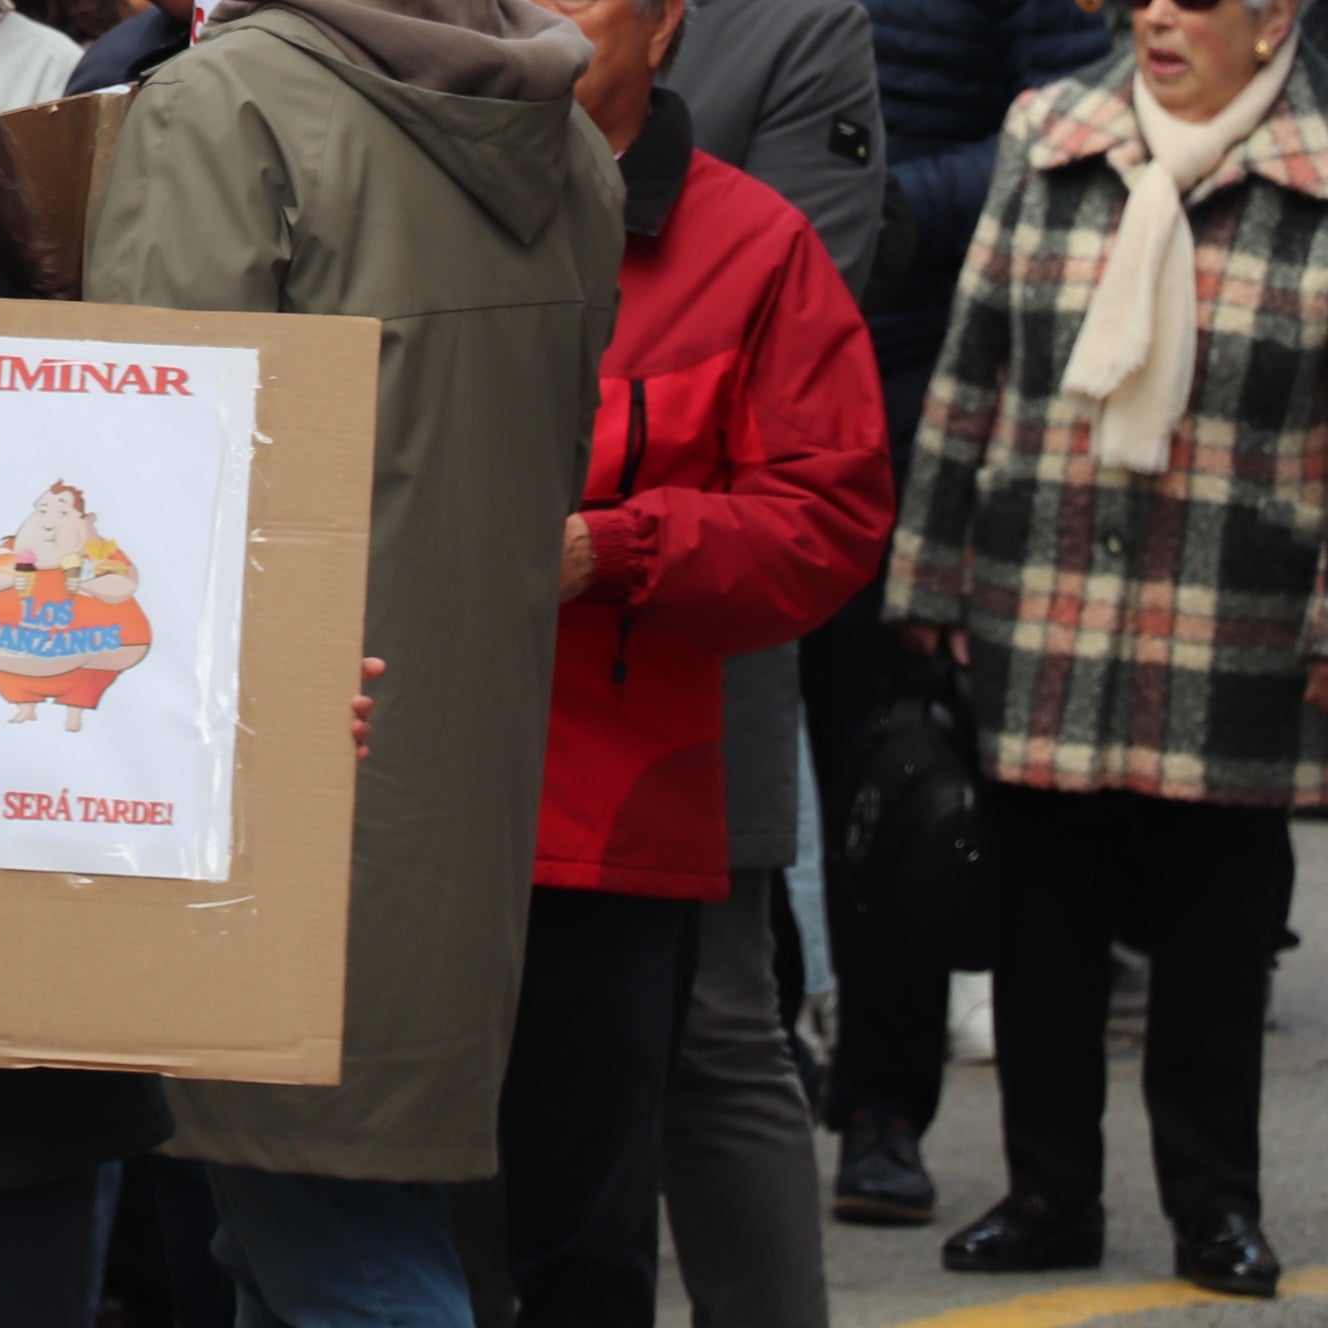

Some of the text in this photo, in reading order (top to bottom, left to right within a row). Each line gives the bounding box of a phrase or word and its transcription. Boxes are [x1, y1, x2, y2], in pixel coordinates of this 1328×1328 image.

[22, 597, 75, 628] LOS
[3, 787, 74, 823] SERÁ
[76, 795, 175, 827] TARDE!
